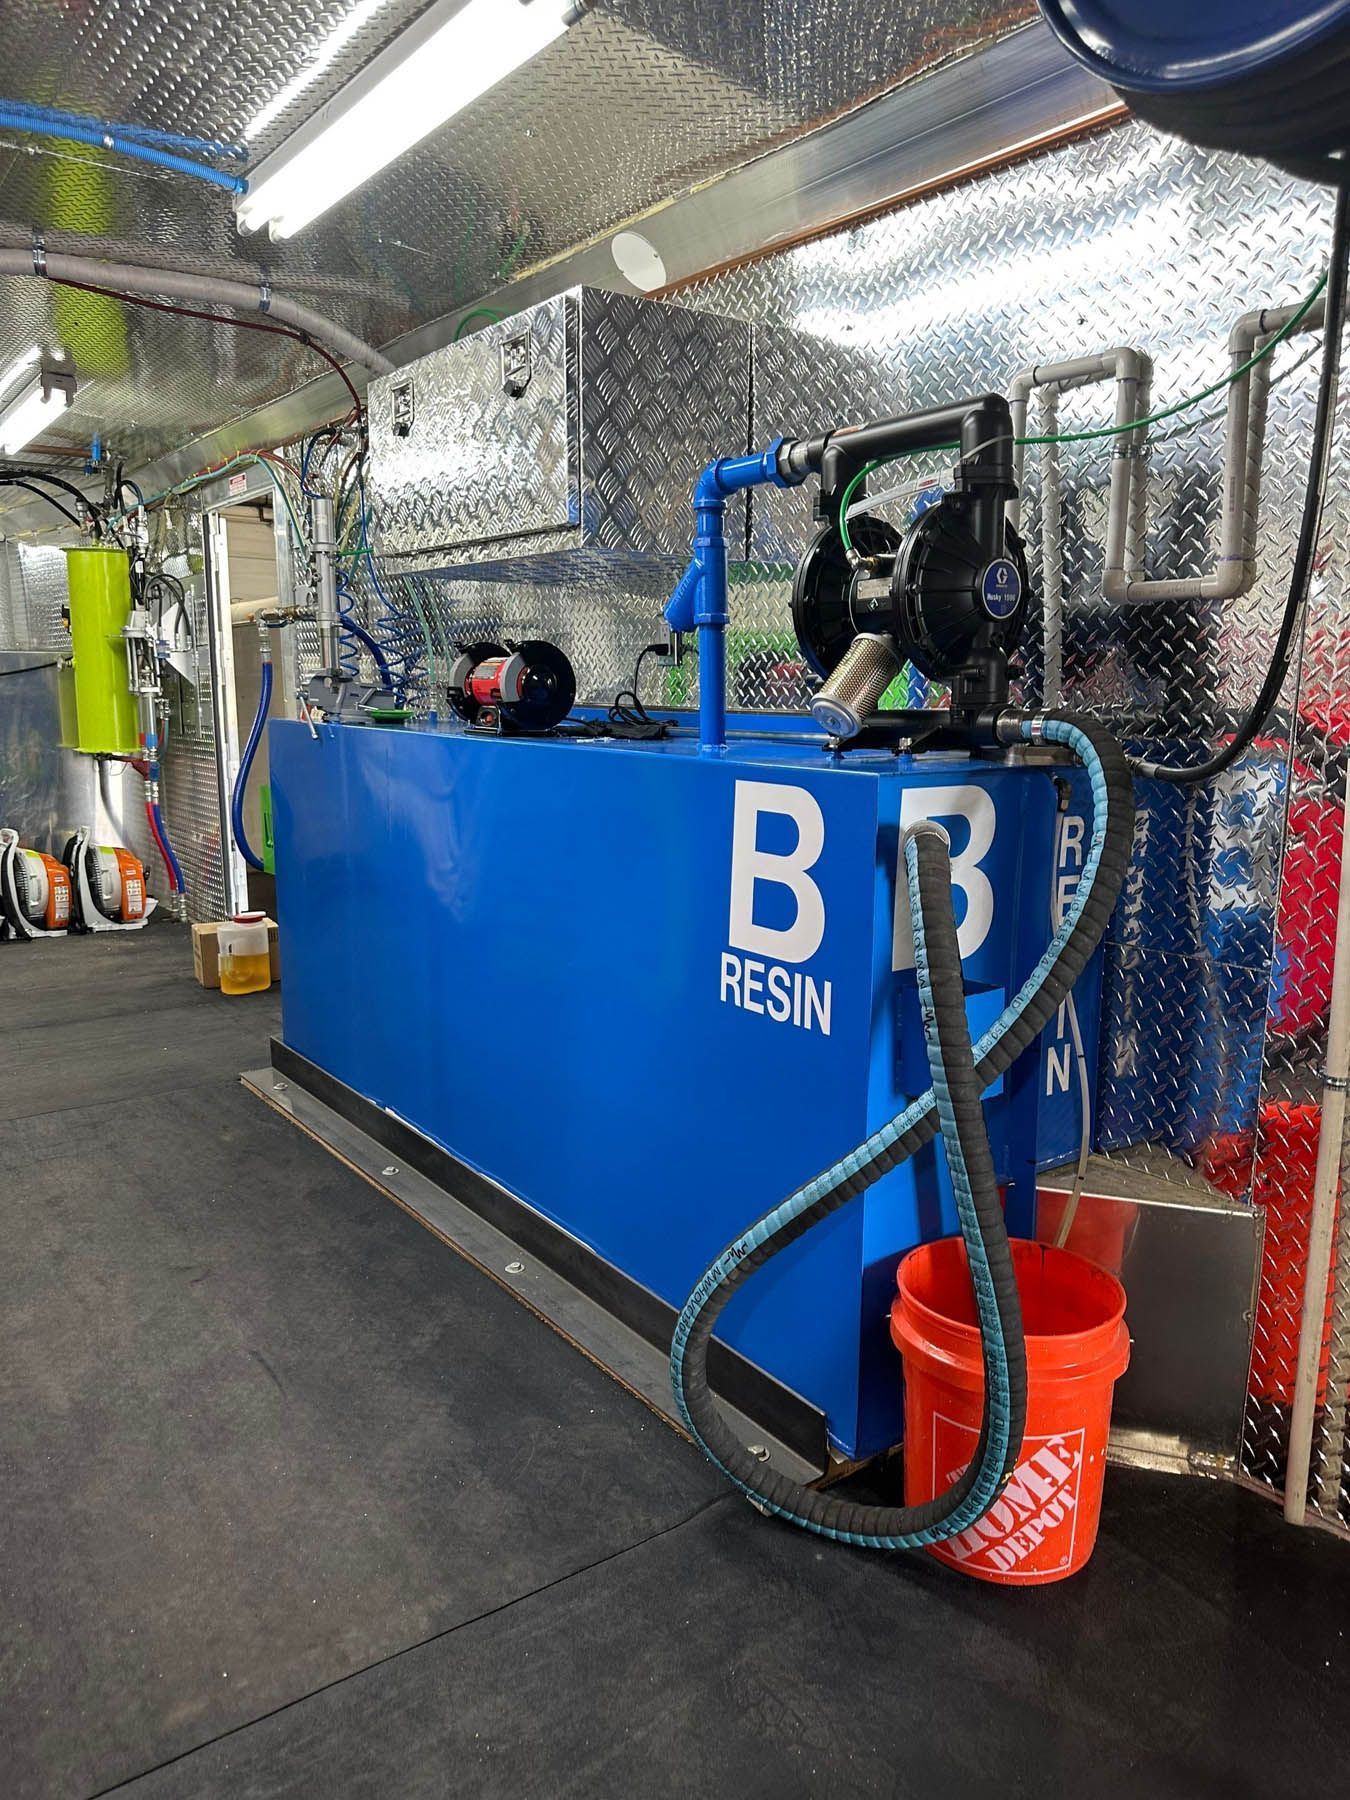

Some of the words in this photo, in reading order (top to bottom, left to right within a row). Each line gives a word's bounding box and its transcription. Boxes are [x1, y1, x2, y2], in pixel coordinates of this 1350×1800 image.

[729, 780, 825, 963] B
[891, 785, 996, 972] B
[720, 951, 832, 1036] RESIN
[1046, 816, 1085, 1096] REIN
[947, 1437, 1081, 1560] HOME
[985, 1485, 1076, 1571] DEPOT
